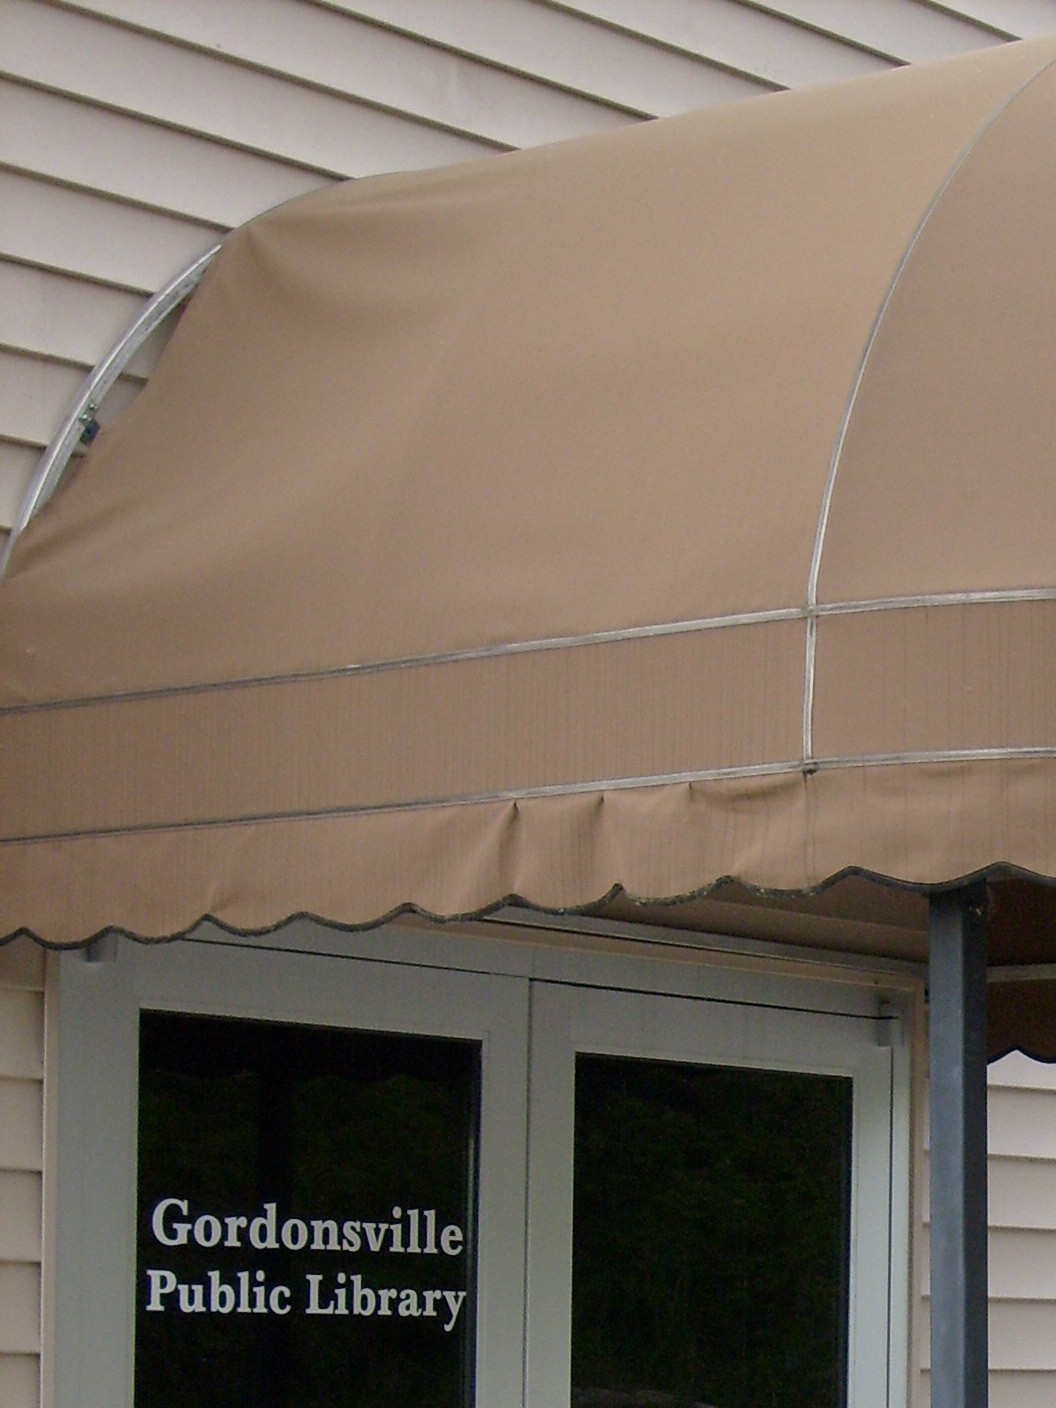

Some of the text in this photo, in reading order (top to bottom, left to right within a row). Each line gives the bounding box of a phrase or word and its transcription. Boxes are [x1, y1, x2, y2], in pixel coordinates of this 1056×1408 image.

[153, 1199, 462, 1255] Gordonsville
[146, 1270, 466, 1331] Public Library
